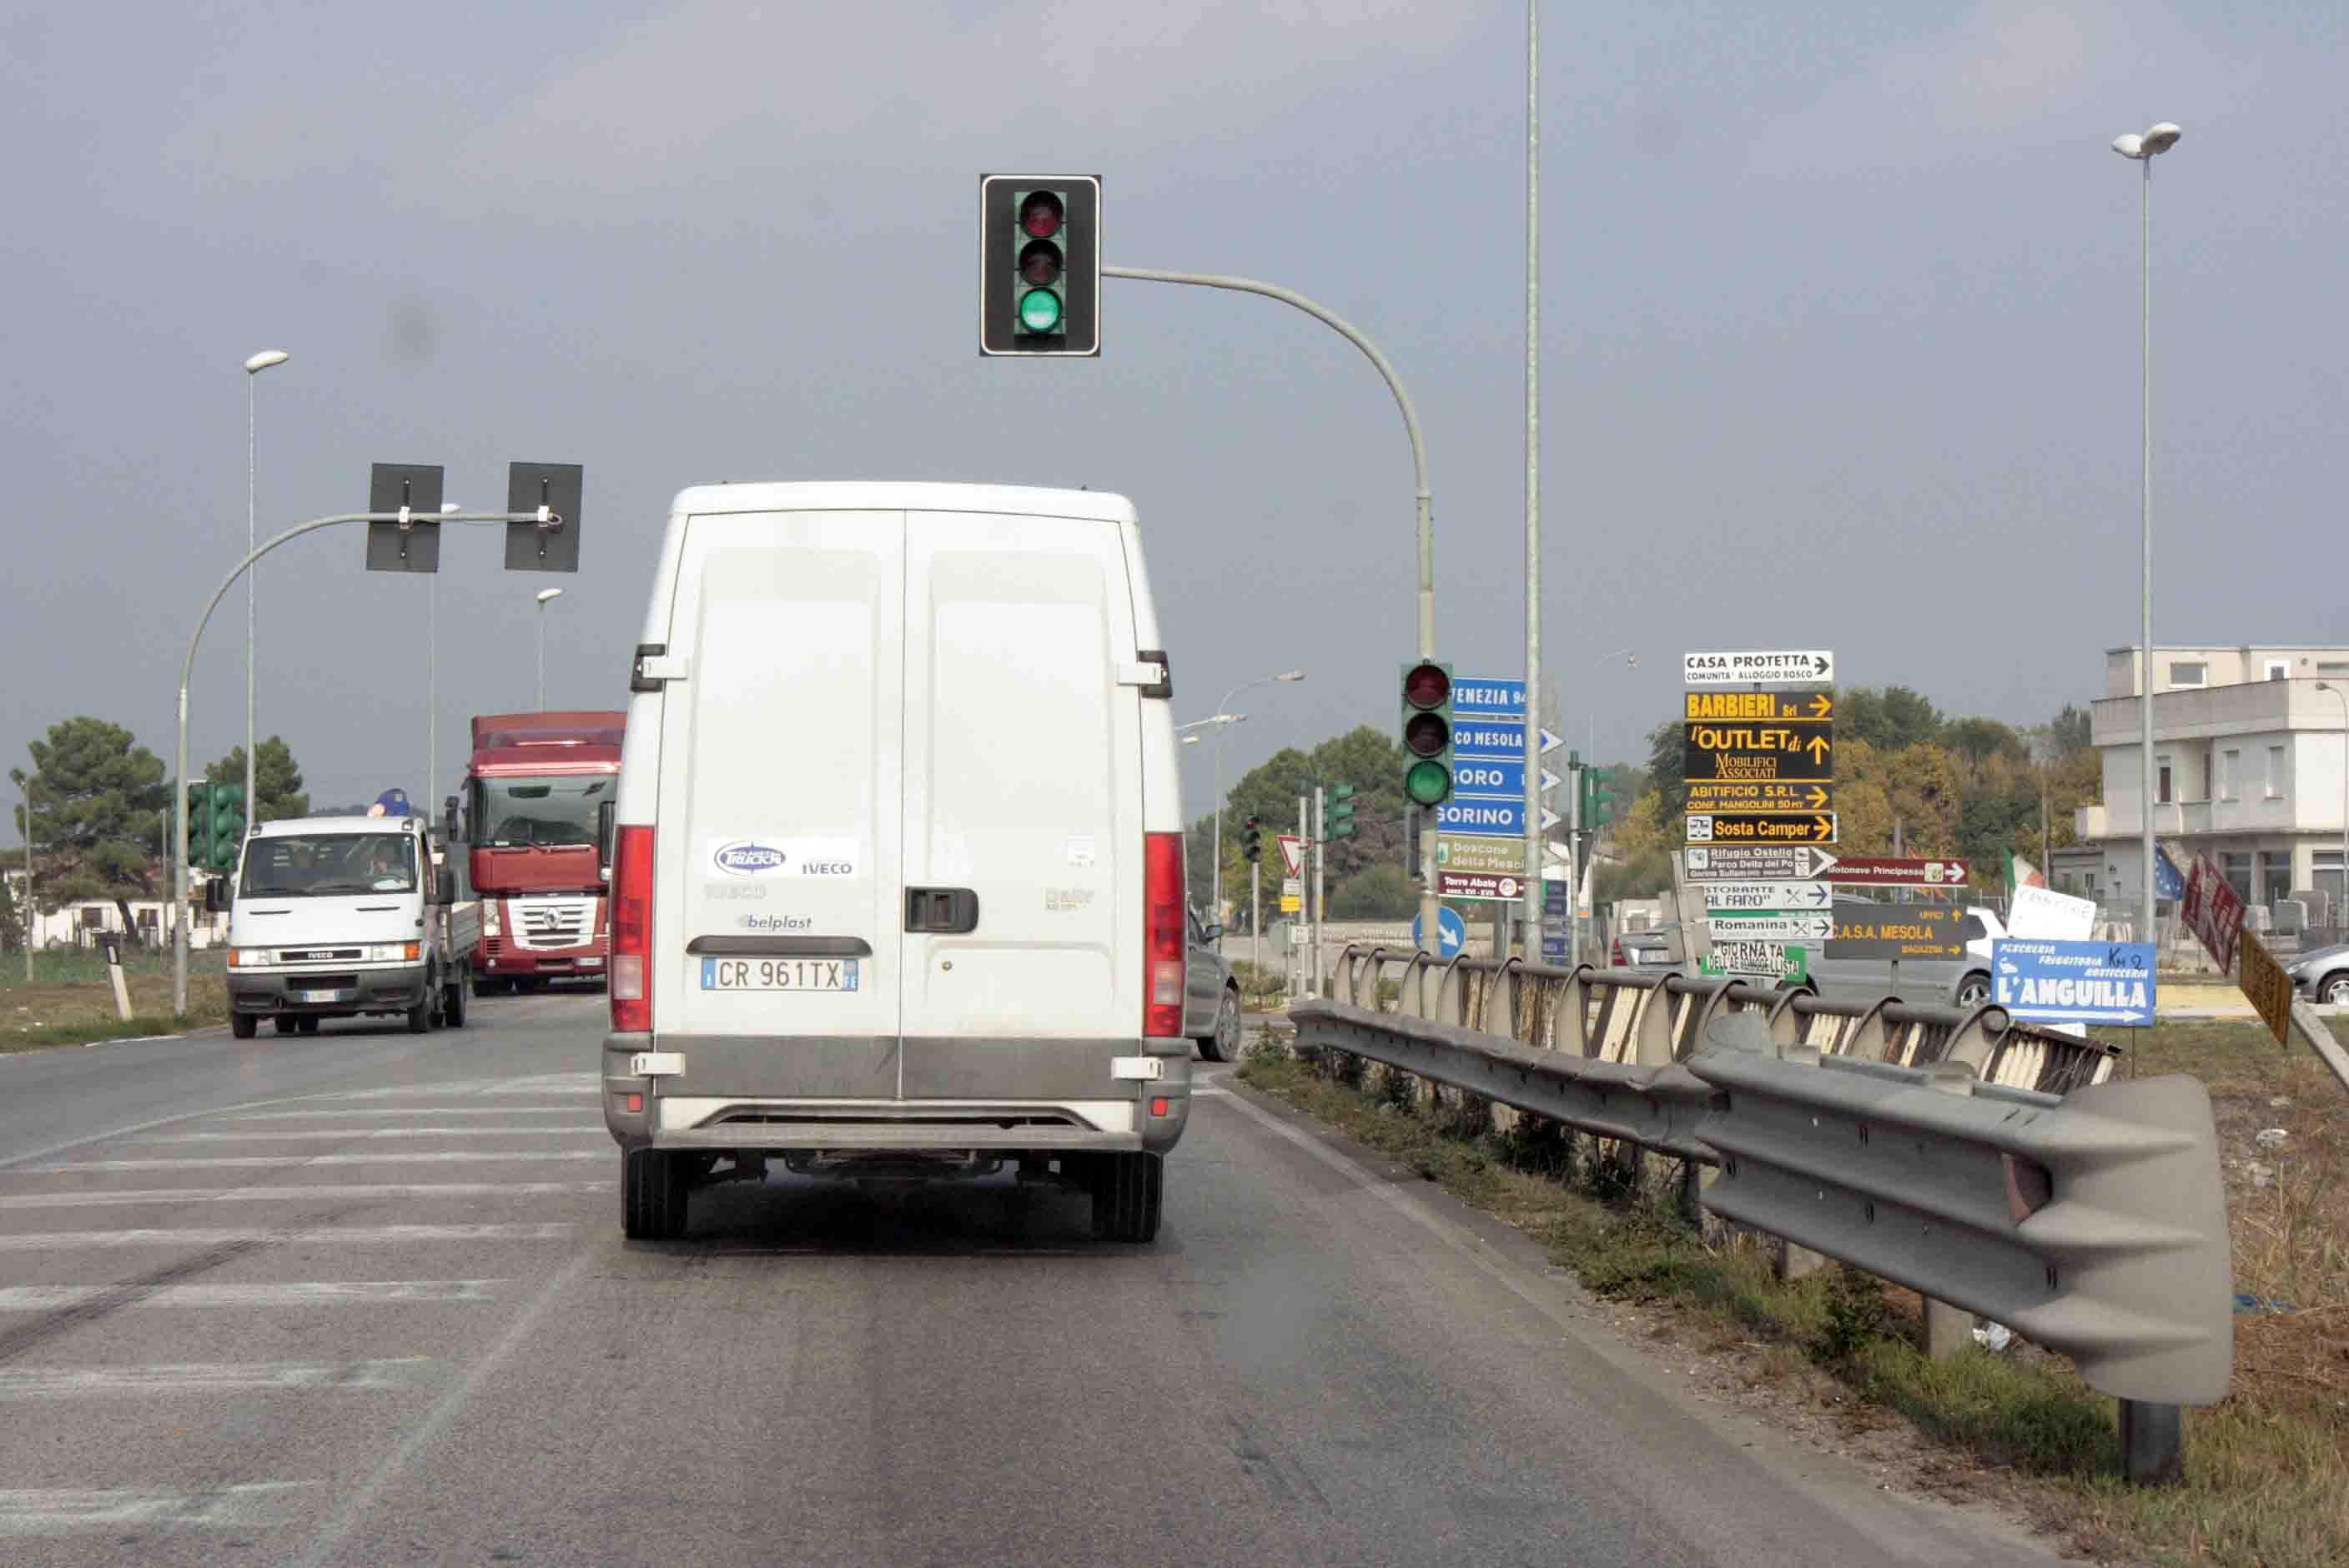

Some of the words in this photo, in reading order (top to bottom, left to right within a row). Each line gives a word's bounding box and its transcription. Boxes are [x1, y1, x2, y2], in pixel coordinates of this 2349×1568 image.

[1687, 656, 1728, 668] CASA
[1733, 655, 1810, 667] PROTETTA
[1738, 670, 1781, 679] ALLOGGIO
[1783, 670, 1813, 678] BOSCO
[1688, 693, 1776, 717] BARBIERI
[1475, 732, 1523, 747] MESOLA
[1788, 735, 1802, 752] di
[1689, 787, 1759, 798] ABITIFICIO
[1714, 821, 1754, 837] Sosta
[1757, 821, 1811, 840] Camper
[1753, 847, 1793, 857] Ostello
[802, 862, 853, 875] IVECO
[1782, 859, 1794, 868] Po
[747, 915, 812, 932] belplast
[1715, 920, 1788, 930] Romanina
[1881, 923, 1934, 940] MESOLA
[2131, 955, 2145, 971] 2
[720, 962, 748, 987] CR
[1998, 977, 2147, 1008] L'ANGUILLA
